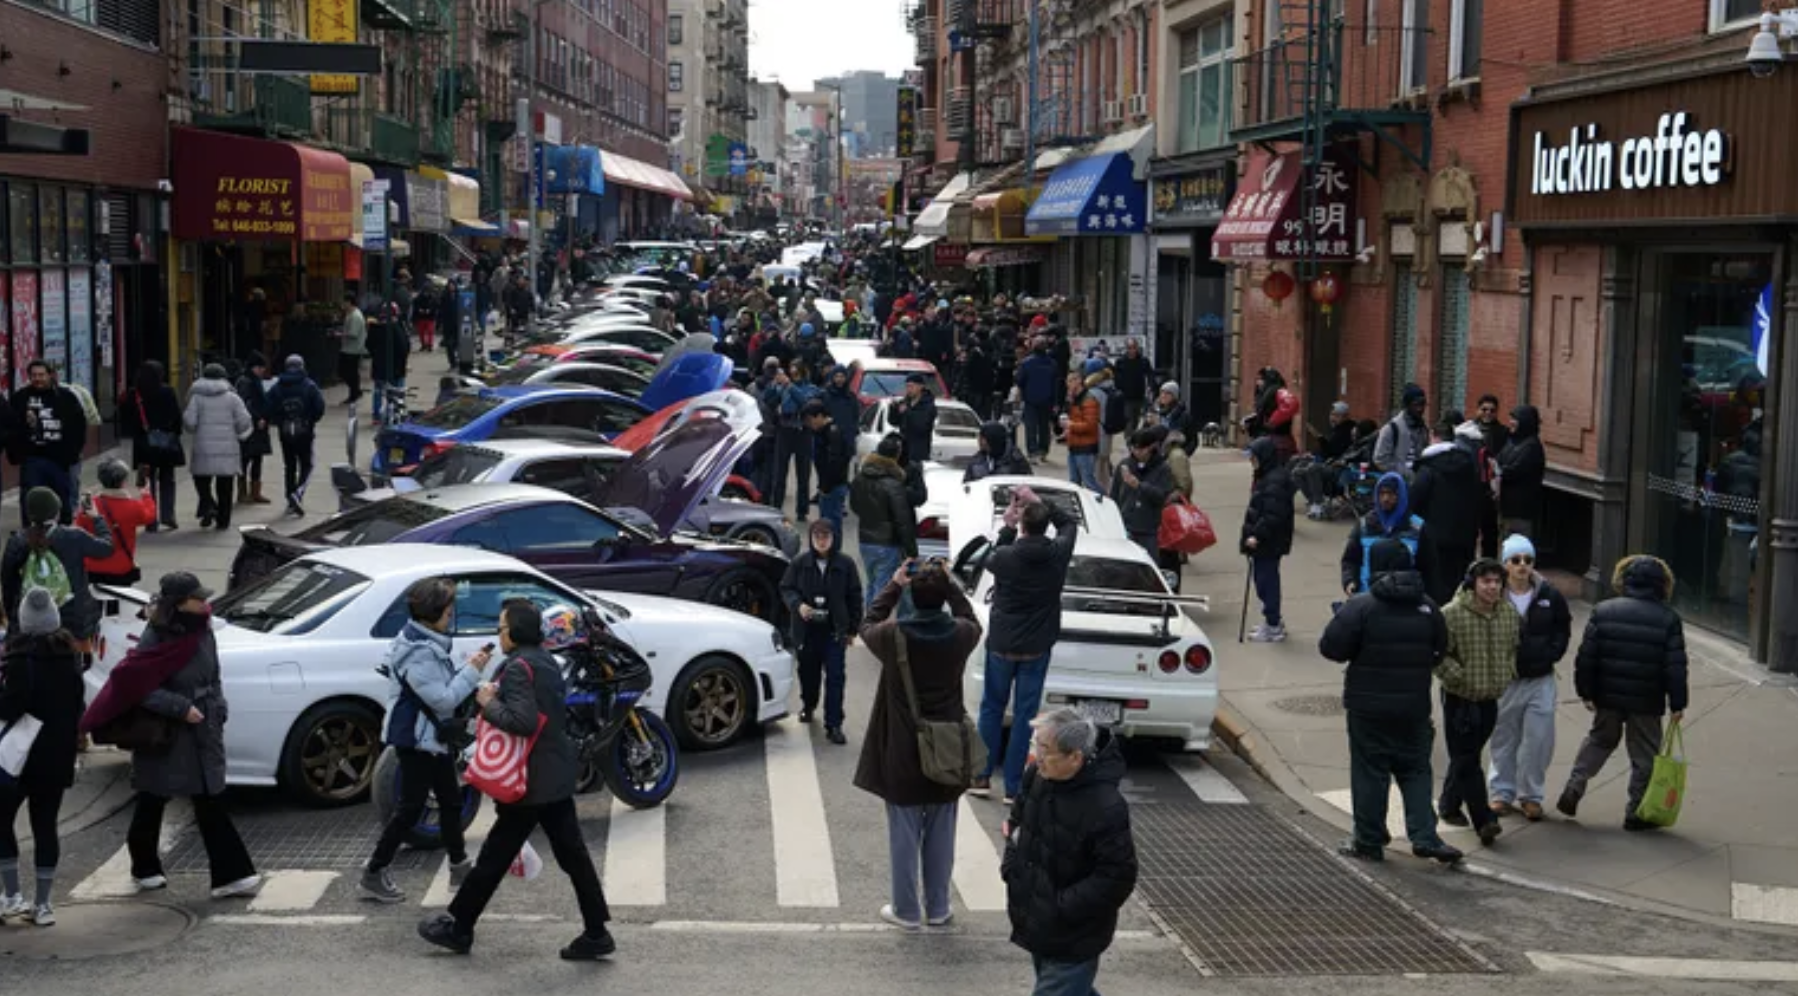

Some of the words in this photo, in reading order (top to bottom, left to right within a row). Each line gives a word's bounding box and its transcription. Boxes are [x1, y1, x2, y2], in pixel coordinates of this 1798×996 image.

[217, 178, 292, 193] FLORIST
[1532, 124, 1613, 194] luckin
[1620, 112, 1722, 189] coffee
[1308, 162, 1349, 234] 永明
